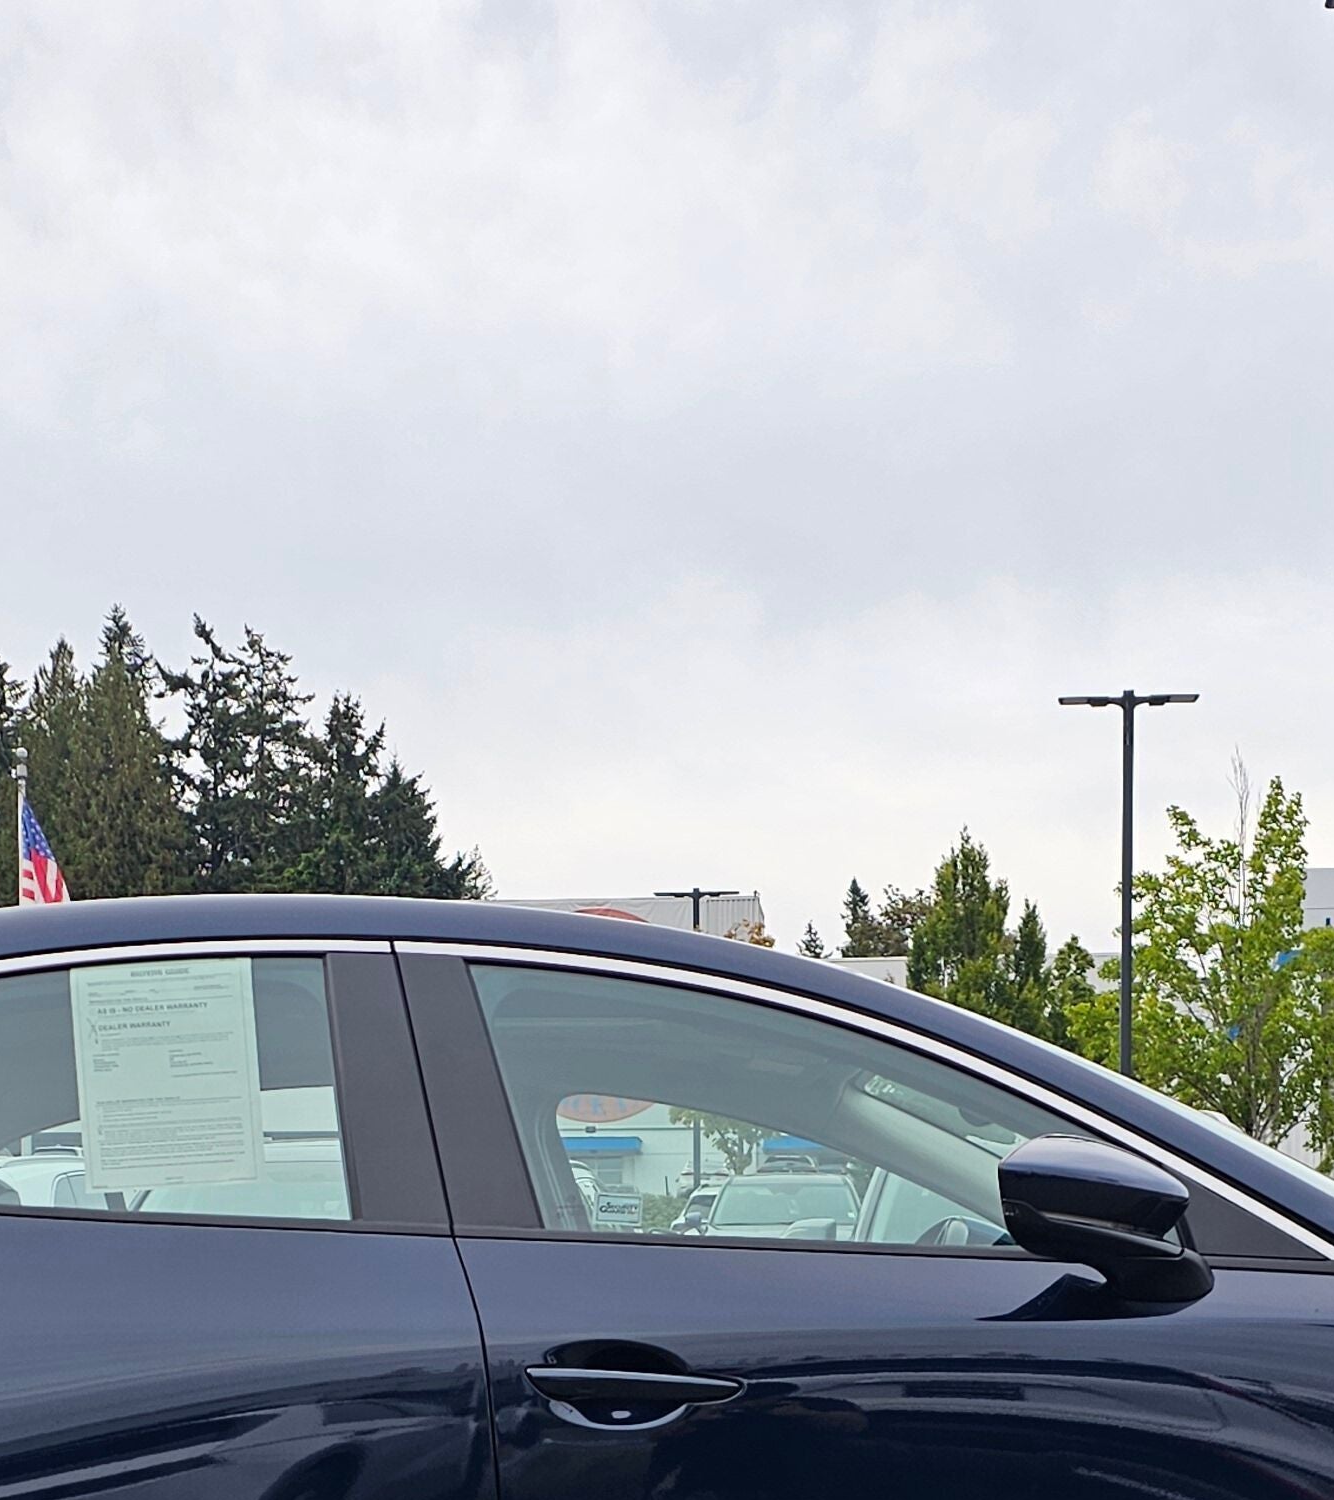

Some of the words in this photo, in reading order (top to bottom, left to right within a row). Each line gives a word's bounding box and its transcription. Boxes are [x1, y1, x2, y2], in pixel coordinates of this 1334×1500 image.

[135, 1004, 164, 1012] DEALER
[166, 1002, 208, 1010] WARRANTY
[98, 1023, 127, 1031] DEALER
[130, 1021, 171, 1029] WARRANTY
